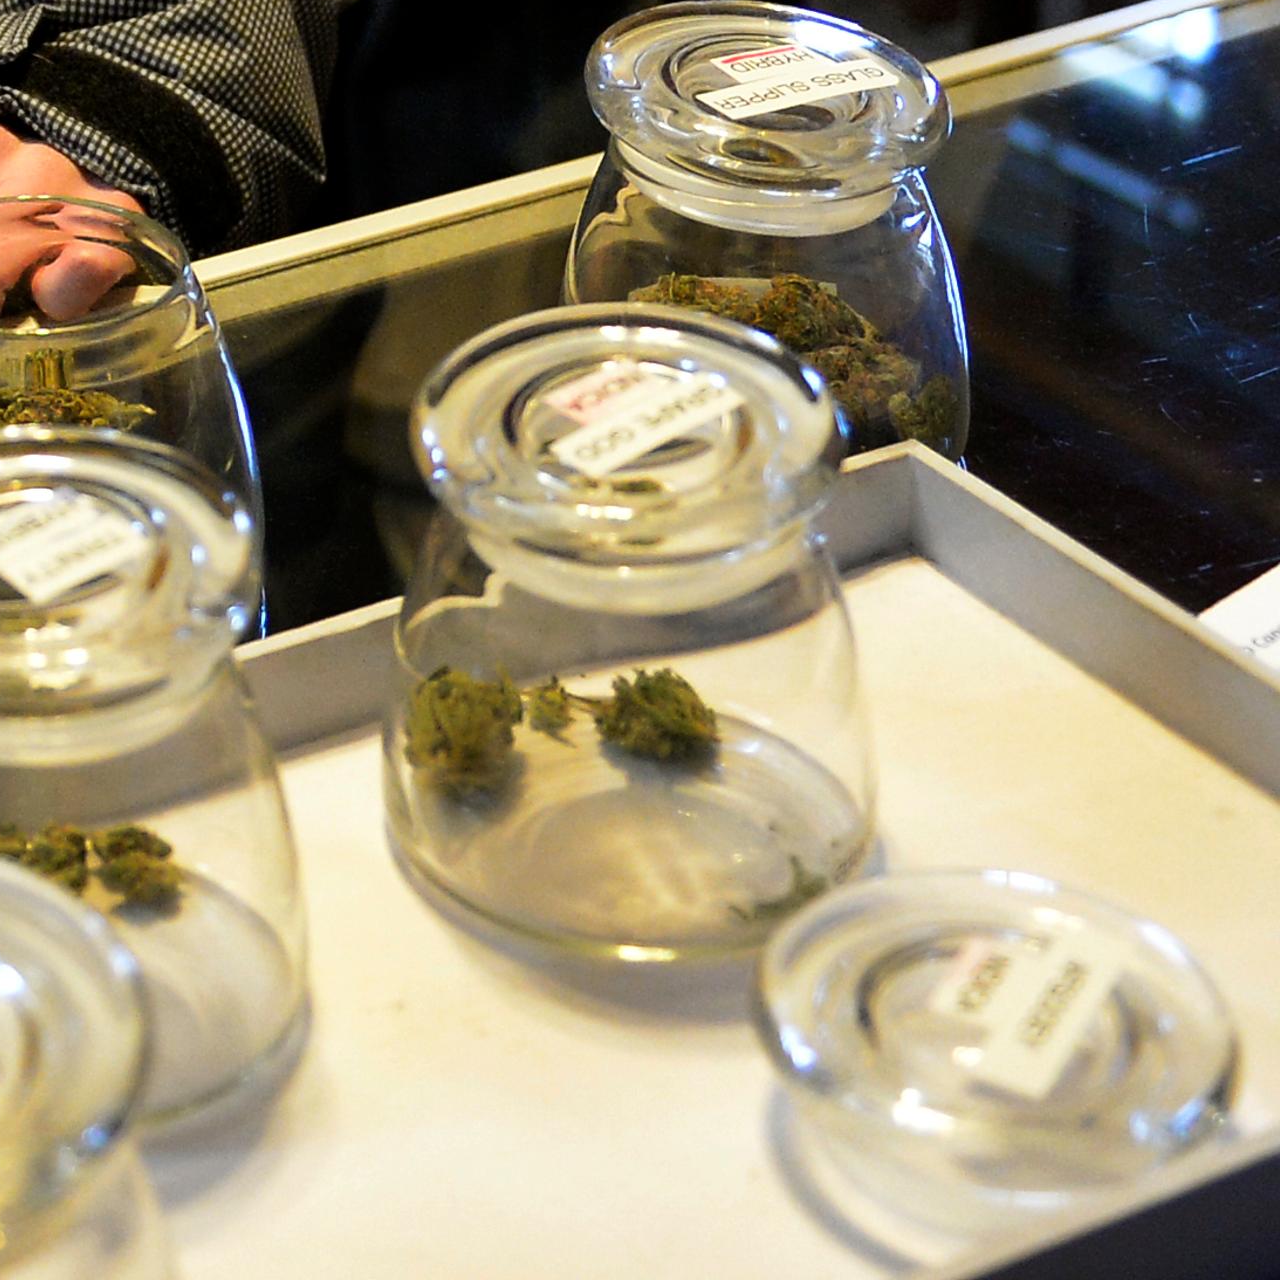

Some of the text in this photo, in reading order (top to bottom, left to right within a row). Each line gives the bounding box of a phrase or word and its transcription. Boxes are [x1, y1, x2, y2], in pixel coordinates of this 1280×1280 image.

[728, 50, 815, 73] HYBRID
[712, 66, 885, 111] GLASS SLIPPER
